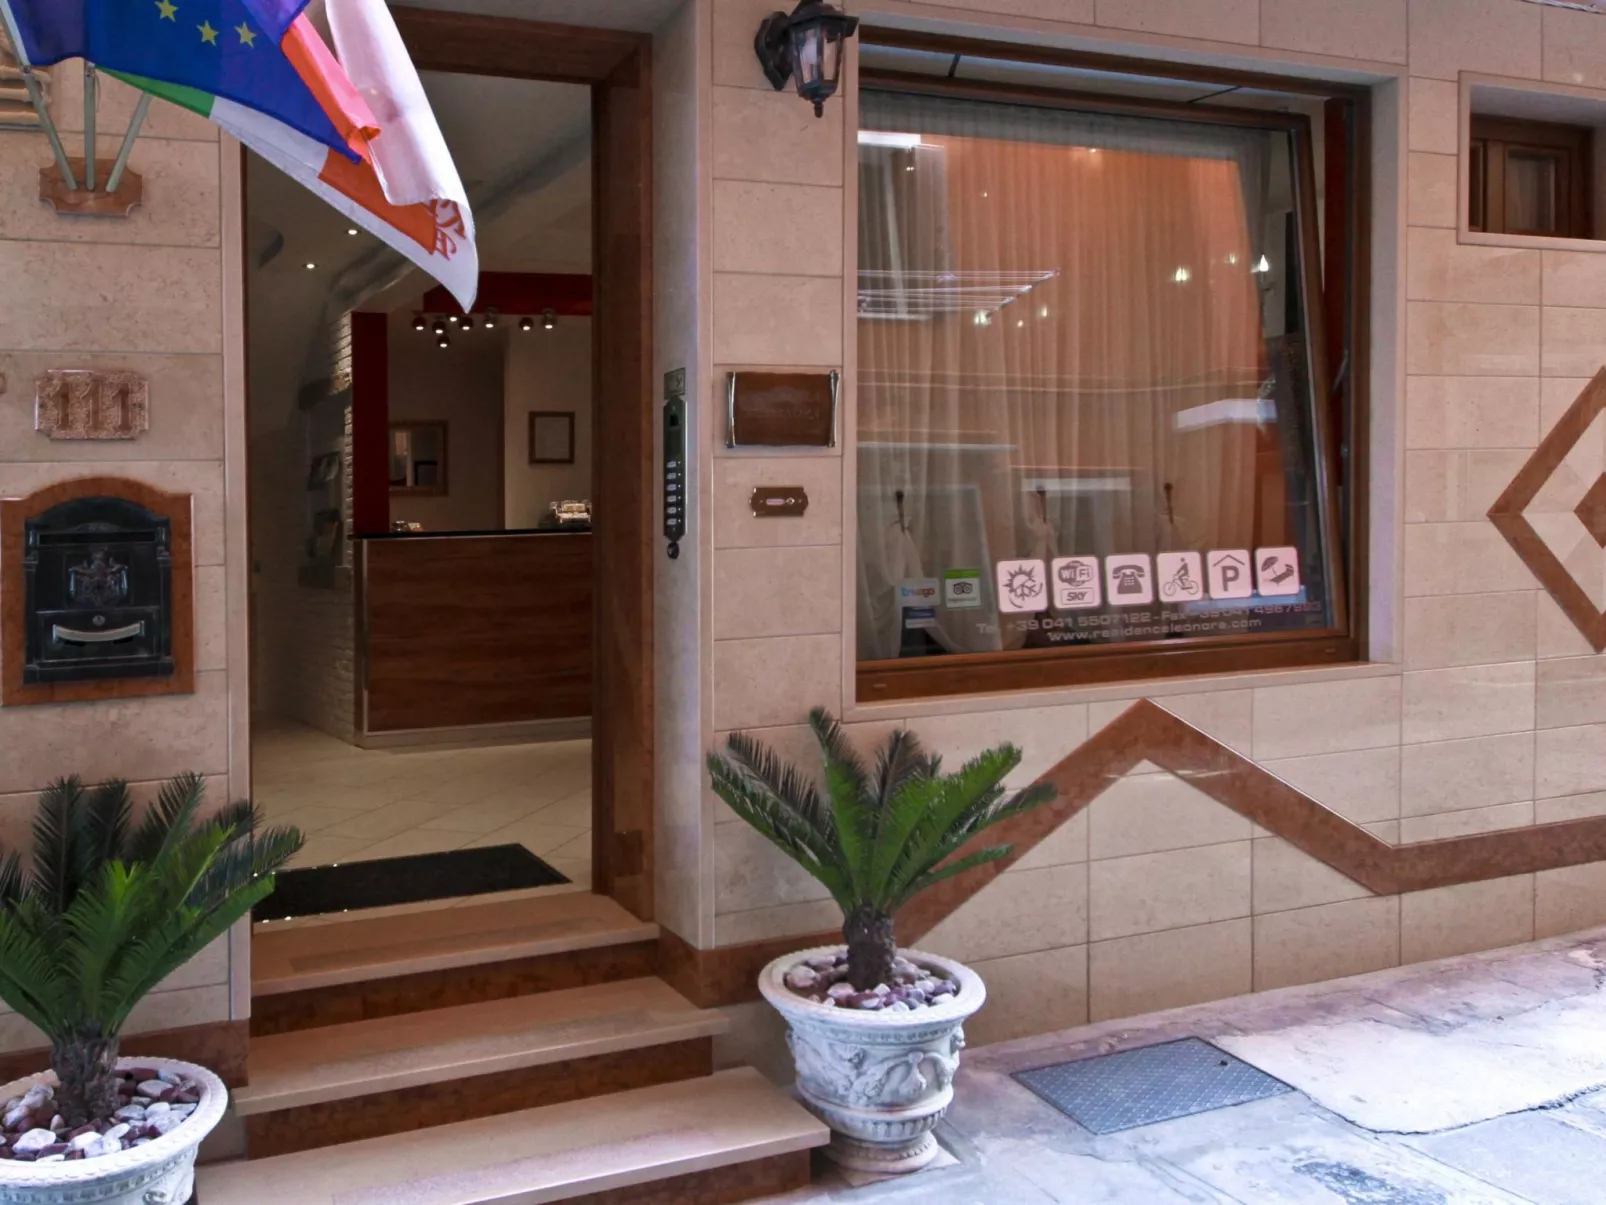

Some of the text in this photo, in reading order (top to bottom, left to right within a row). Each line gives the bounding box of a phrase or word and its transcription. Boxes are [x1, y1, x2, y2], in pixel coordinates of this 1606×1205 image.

[1221, 565, 1240, 592] P
[1066, 591, 1089, 602] SKY
[1042, 617, 1073, 630] 041
